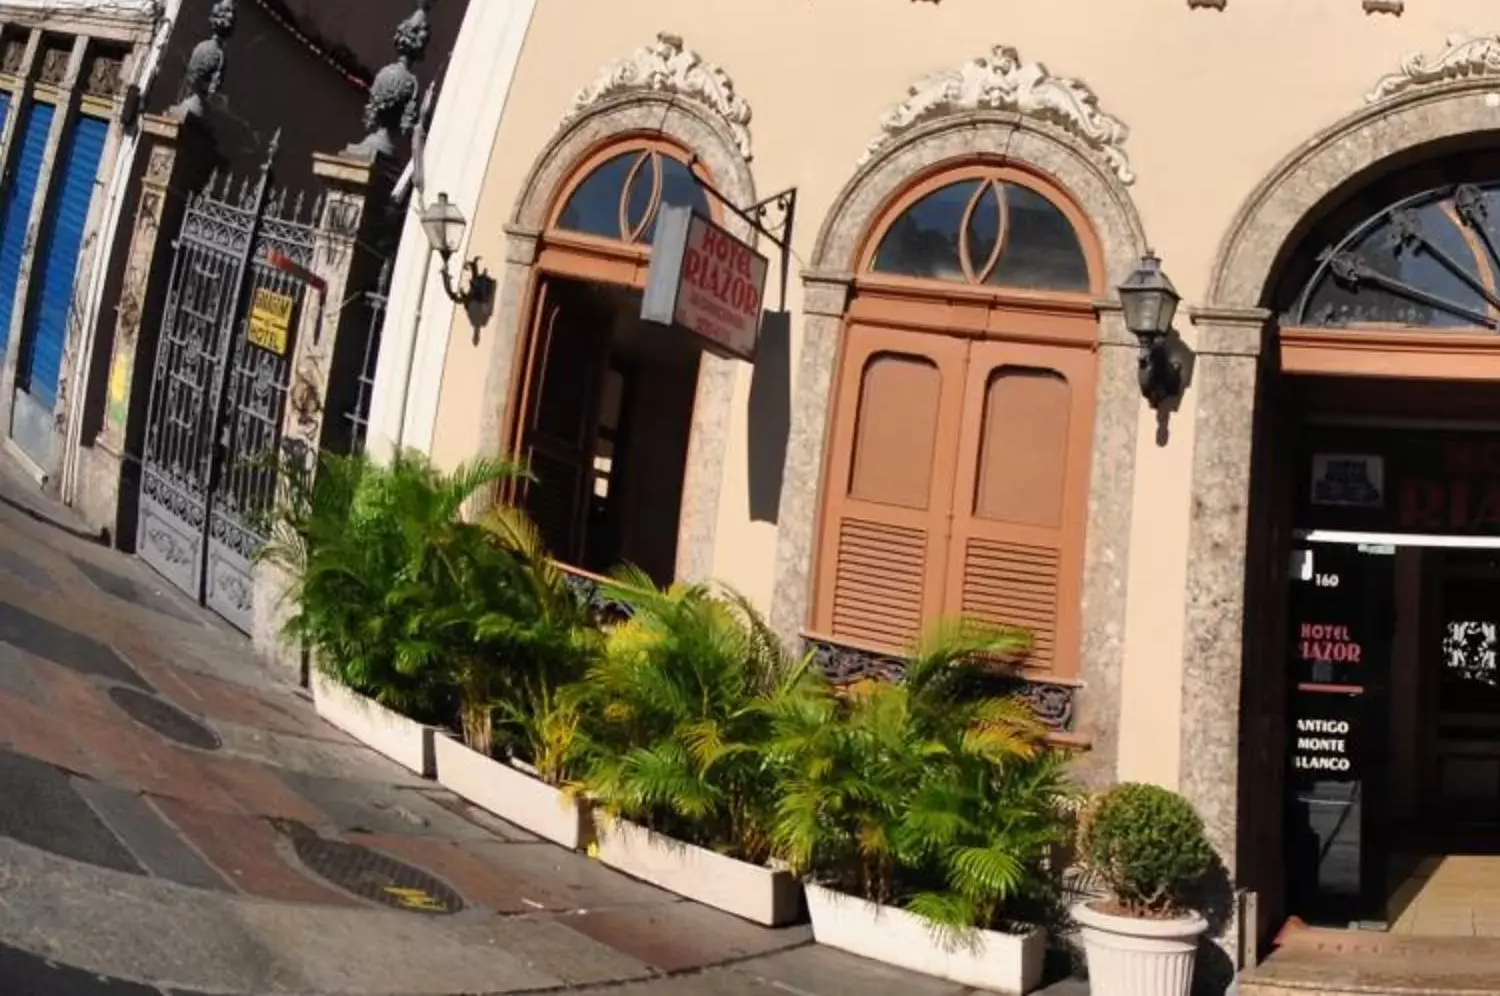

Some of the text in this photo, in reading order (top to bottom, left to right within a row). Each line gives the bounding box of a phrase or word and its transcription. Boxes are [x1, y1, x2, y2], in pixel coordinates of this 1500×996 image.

[701, 226, 752, 280] HOTEL
[684, 247, 759, 317] RIAZOR
[1314, 573, 1340, 587] 160
[1301, 622, 1350, 641] HOTEL
[1299, 641, 1361, 662] IAZOR
[1297, 719, 1349, 734] ANTIGO
[1297, 737, 1346, 753] MONTE
